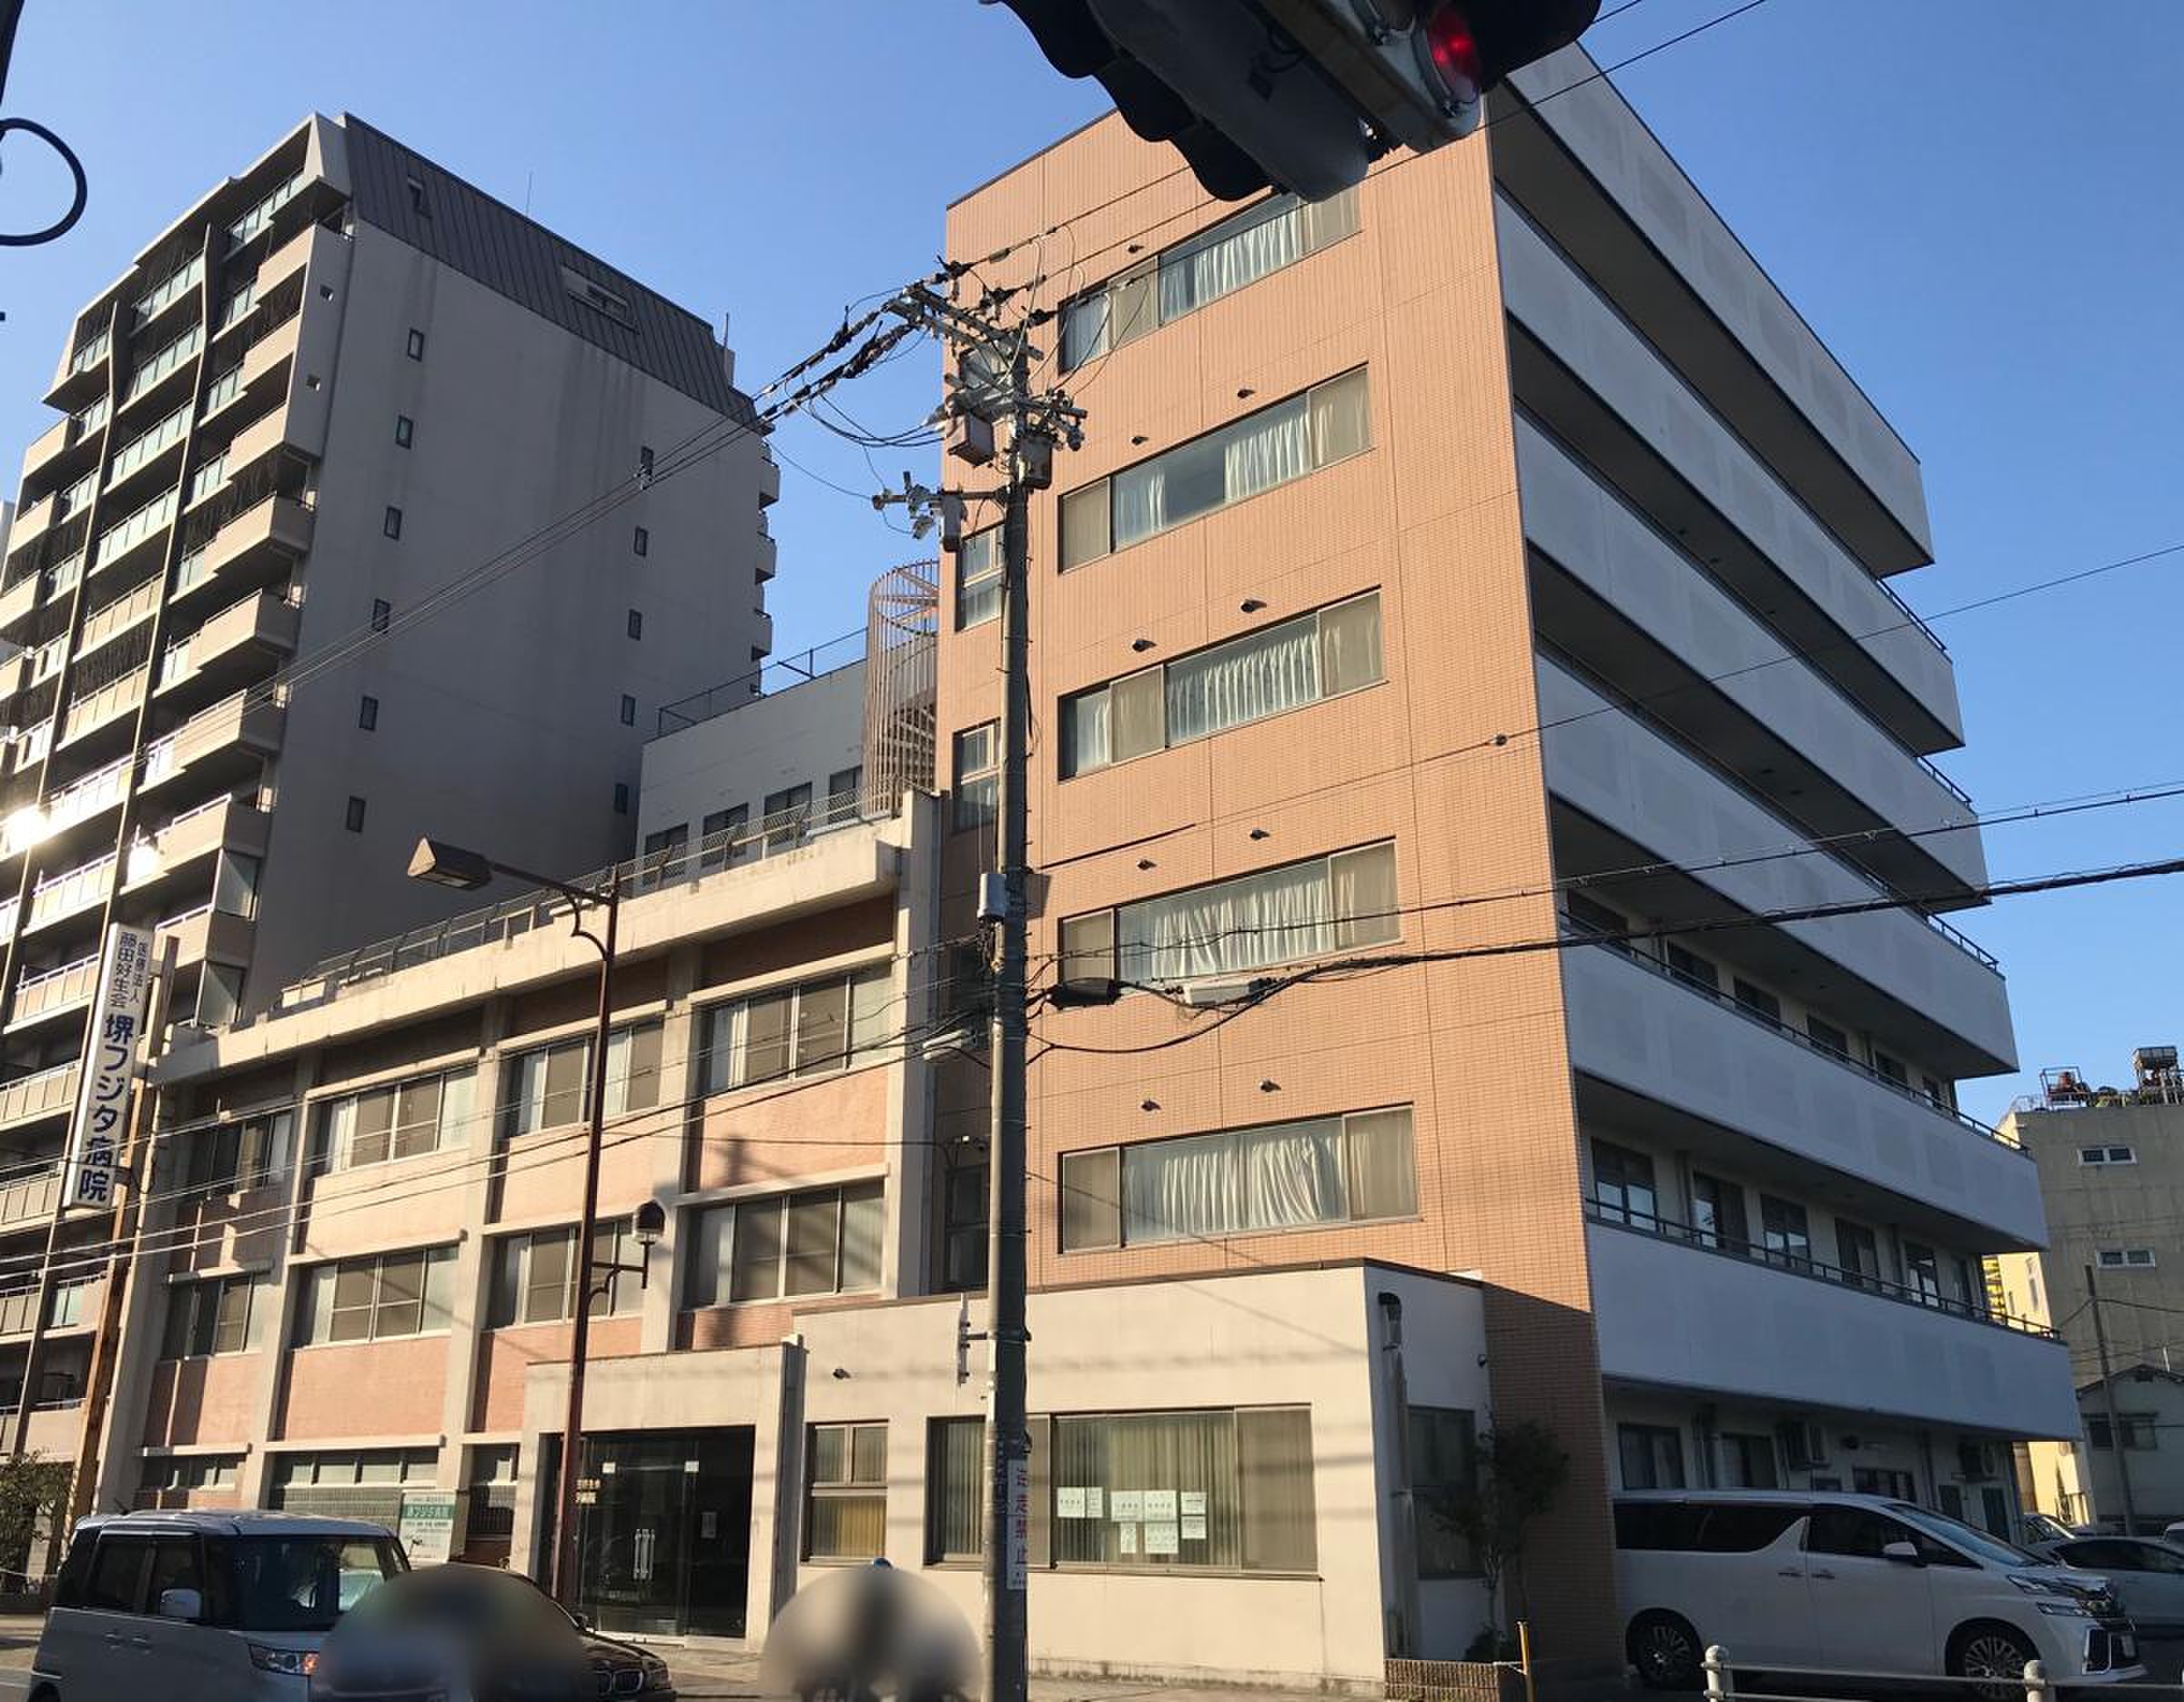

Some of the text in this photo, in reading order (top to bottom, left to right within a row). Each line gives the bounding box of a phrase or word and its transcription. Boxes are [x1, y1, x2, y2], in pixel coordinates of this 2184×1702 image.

[77, 1013, 134, 1201] 堺フジタ病院
